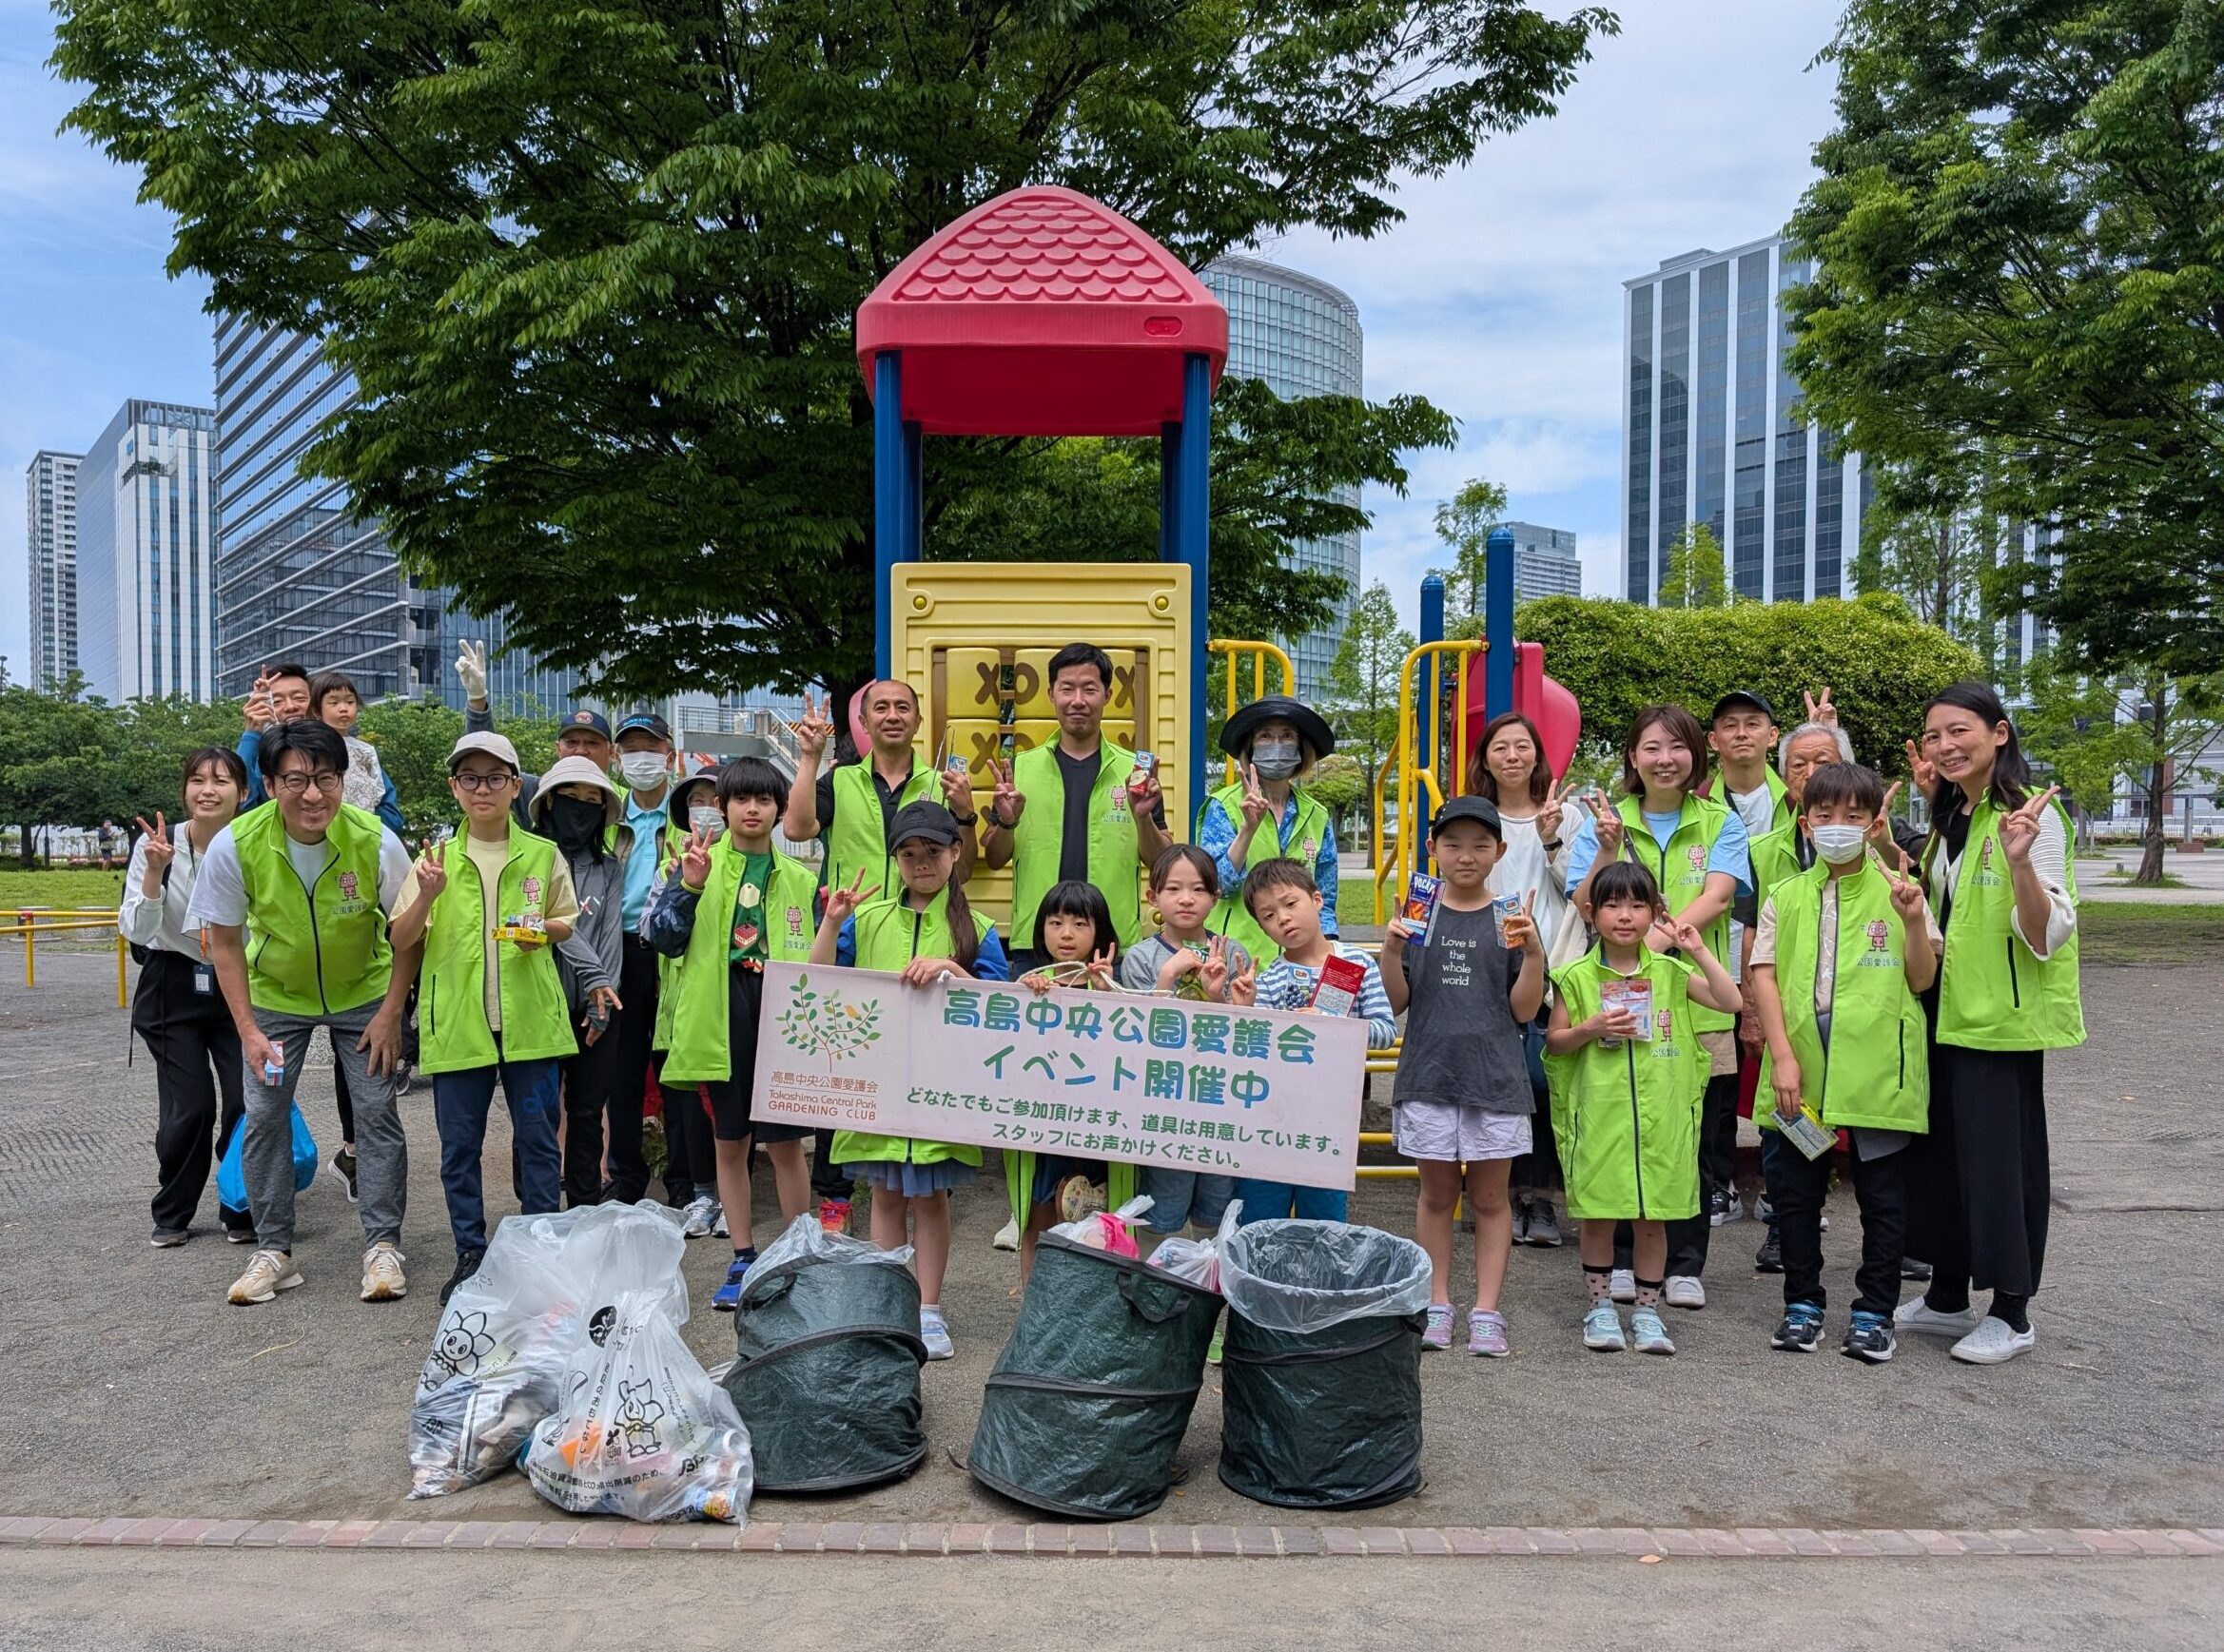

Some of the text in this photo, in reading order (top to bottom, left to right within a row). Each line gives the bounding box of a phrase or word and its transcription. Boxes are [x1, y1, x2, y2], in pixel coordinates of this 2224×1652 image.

[1441, 936, 1476, 948] Love is
[1449, 949, 1466, 961] the
[1442, 962, 1472, 973] whole
[1442, 976, 1470, 985] world
[944, 988, 1317, 1065] 高島中央公園愛護会
[771, 1071, 878, 1094] 高島中央公園愛護会
[984, 1044, 1270, 1109] イベント開催中
[769, 1089, 876, 1110] Takashima Central Park
[768, 1100, 876, 1121] GARDENING CLUB
[907, 1086, 1340, 1156] どなたでもご参加頂けます、道具は用意しています。
[992, 1122, 1240, 1169] スタッフにお声かけください。
